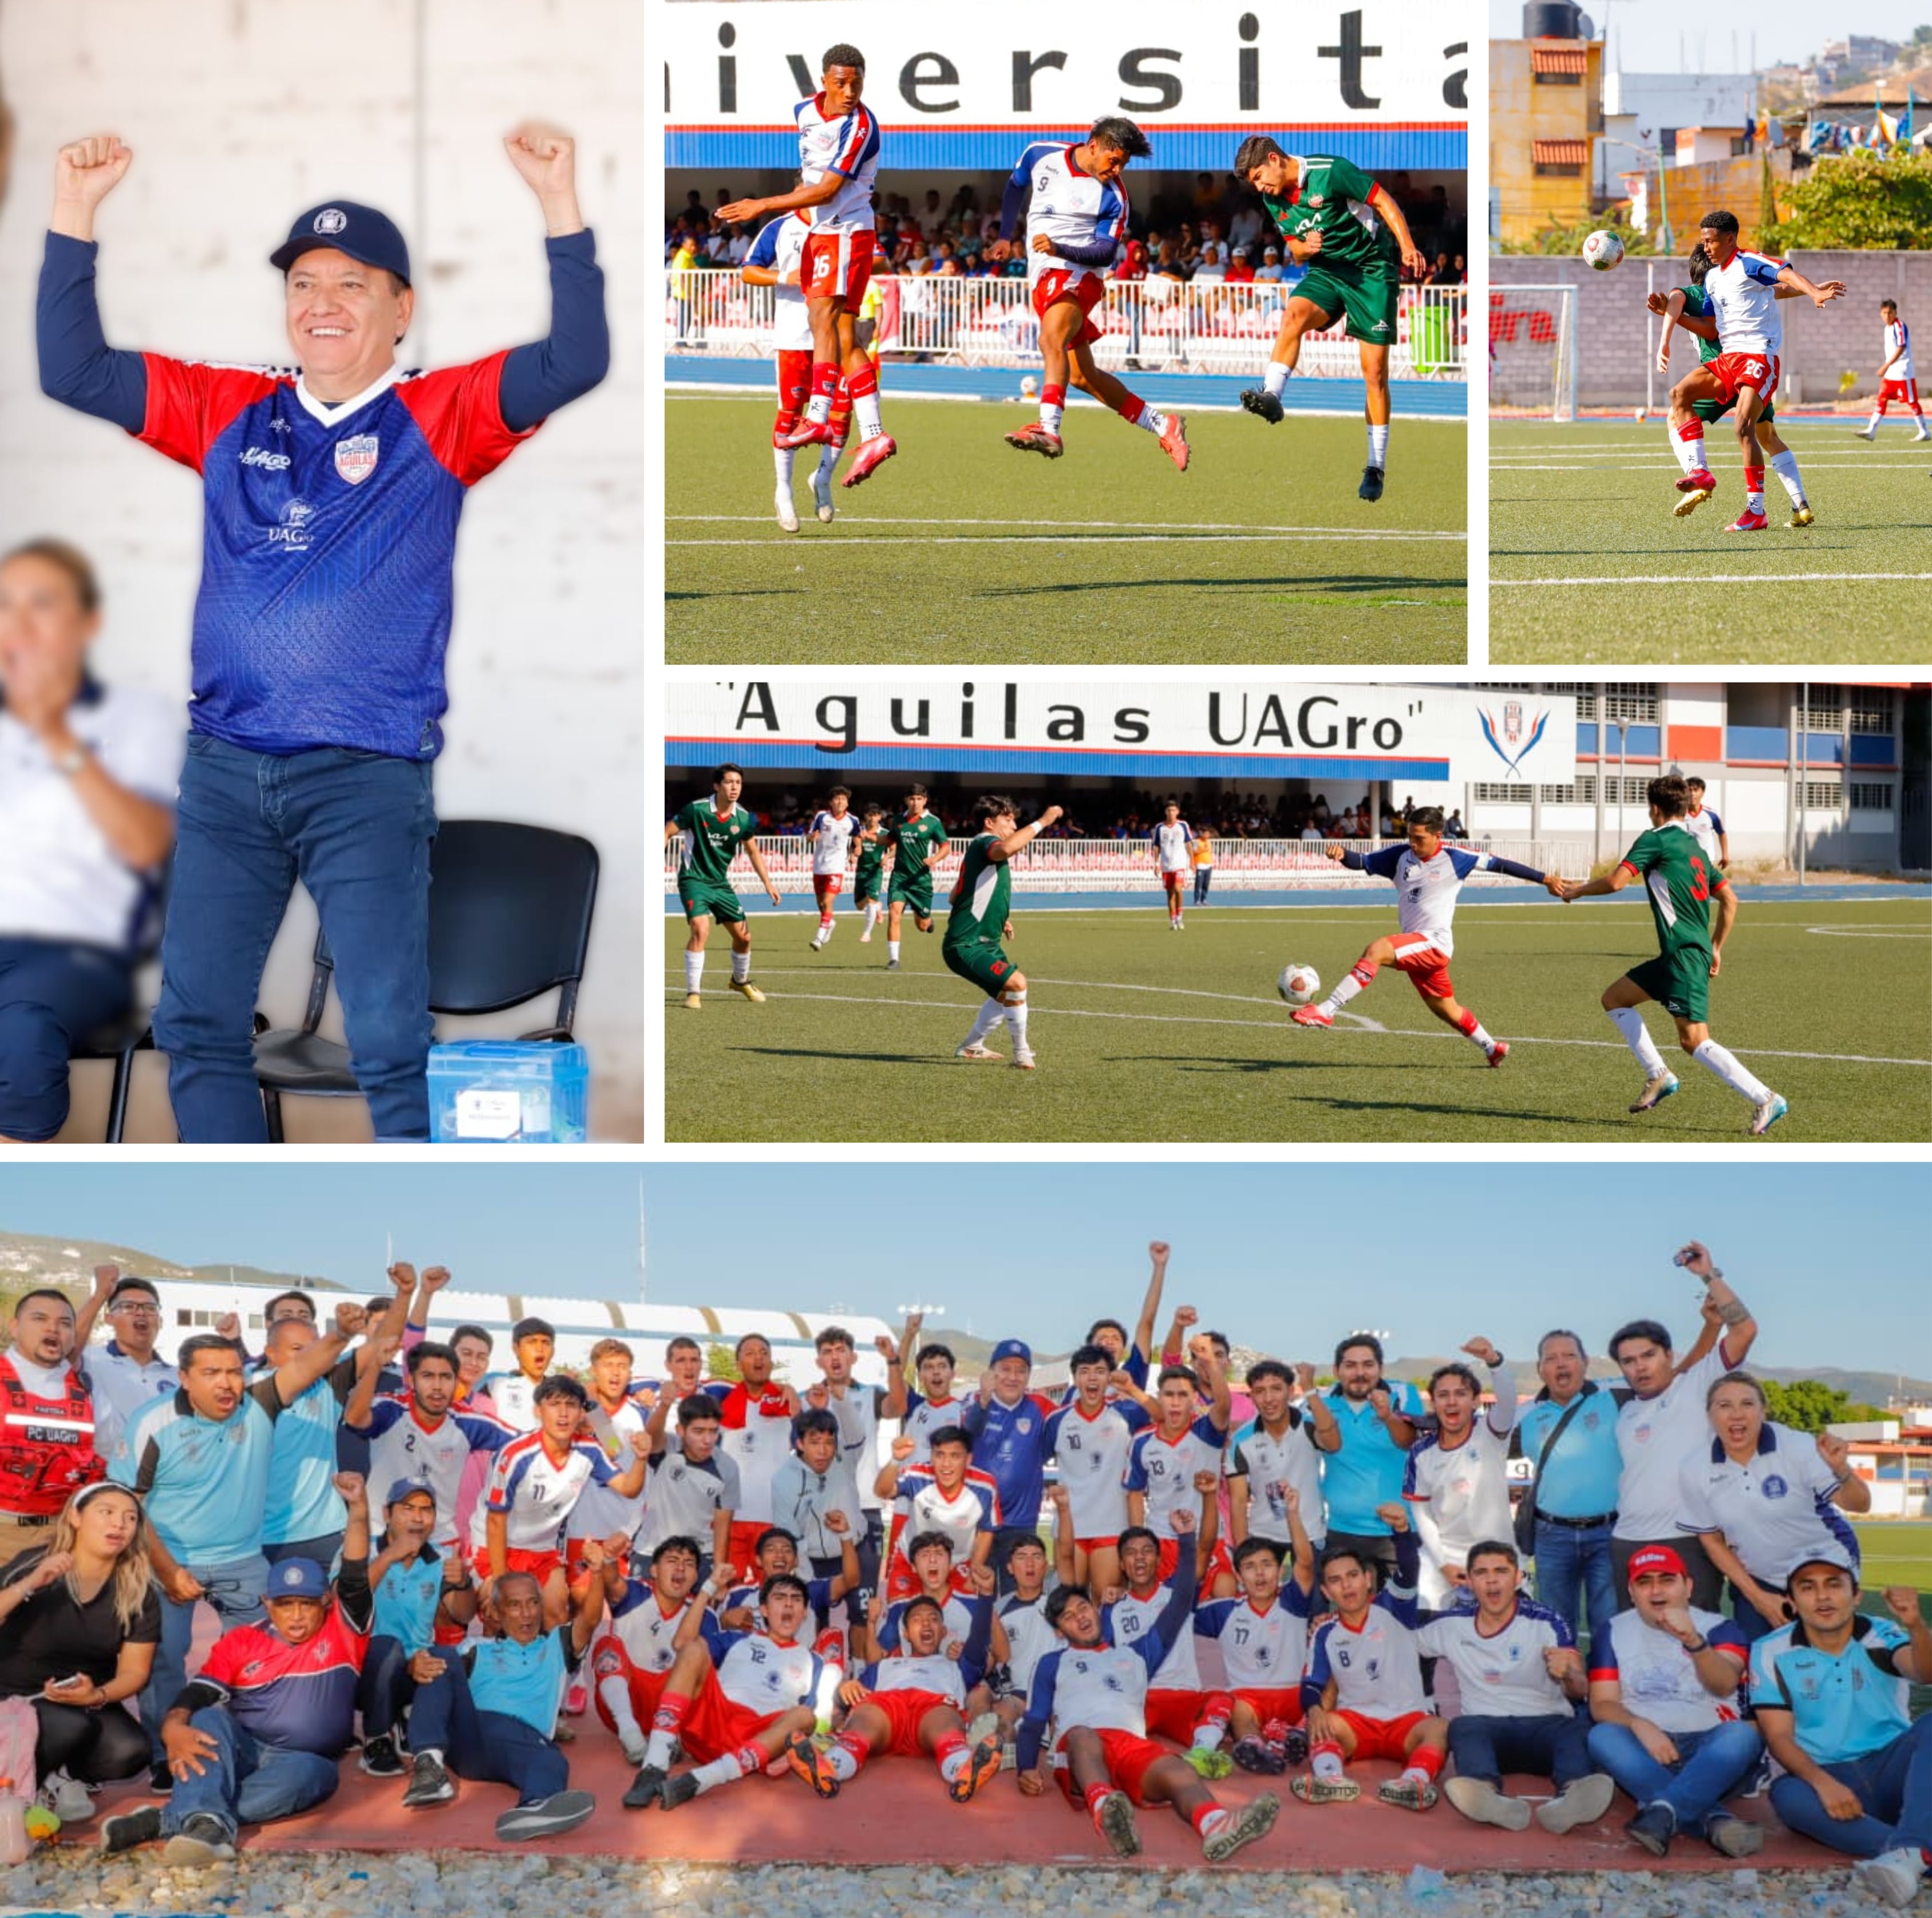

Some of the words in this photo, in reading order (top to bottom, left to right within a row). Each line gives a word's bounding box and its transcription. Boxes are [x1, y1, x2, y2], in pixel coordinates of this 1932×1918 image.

[665, 9, 1468, 113] iersit
[1745, 359, 1765, 379] 26
[1690, 855, 1708, 901] 3
[27, 1425, 44, 1440] PC
[405, 1434, 415, 1453] 2
[1067, 1435, 1081, 1450] 10
[1149, 1460, 1164, 1475] 13
[533, 1484, 546, 1500] 11
[1121, 1615, 1139, 1633] 20
[1235, 1627, 1249, 1645] 17
[750, 1647, 766, 1664] 12
[1340, 1651, 1350, 1667] 8
[1076, 1661, 1087, 1675] 9
